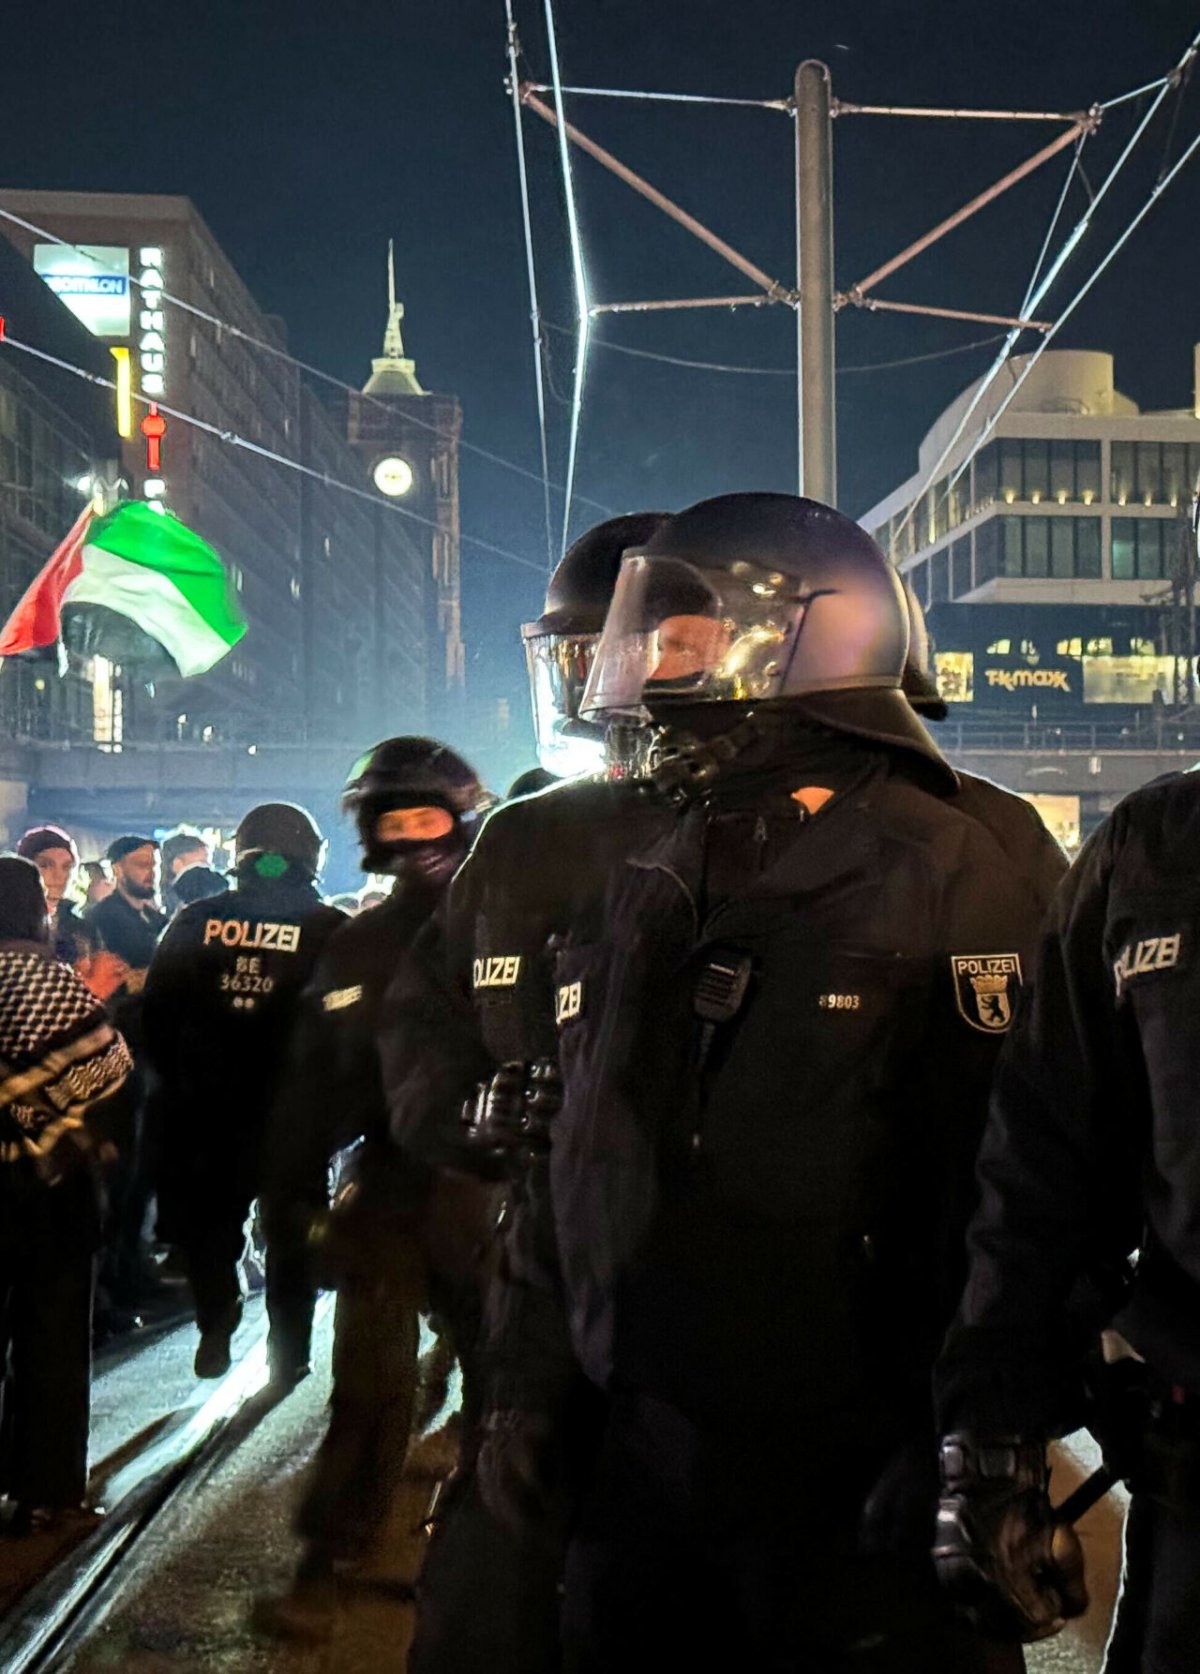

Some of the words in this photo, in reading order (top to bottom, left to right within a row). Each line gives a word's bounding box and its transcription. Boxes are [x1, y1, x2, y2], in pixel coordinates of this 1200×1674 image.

[140, 247, 165, 394] RATHAUS
[204, 919, 301, 952] POLIZEI
[472, 956, 521, 989] OLIZEI
[957, 957, 1016, 976] POLIZEI
